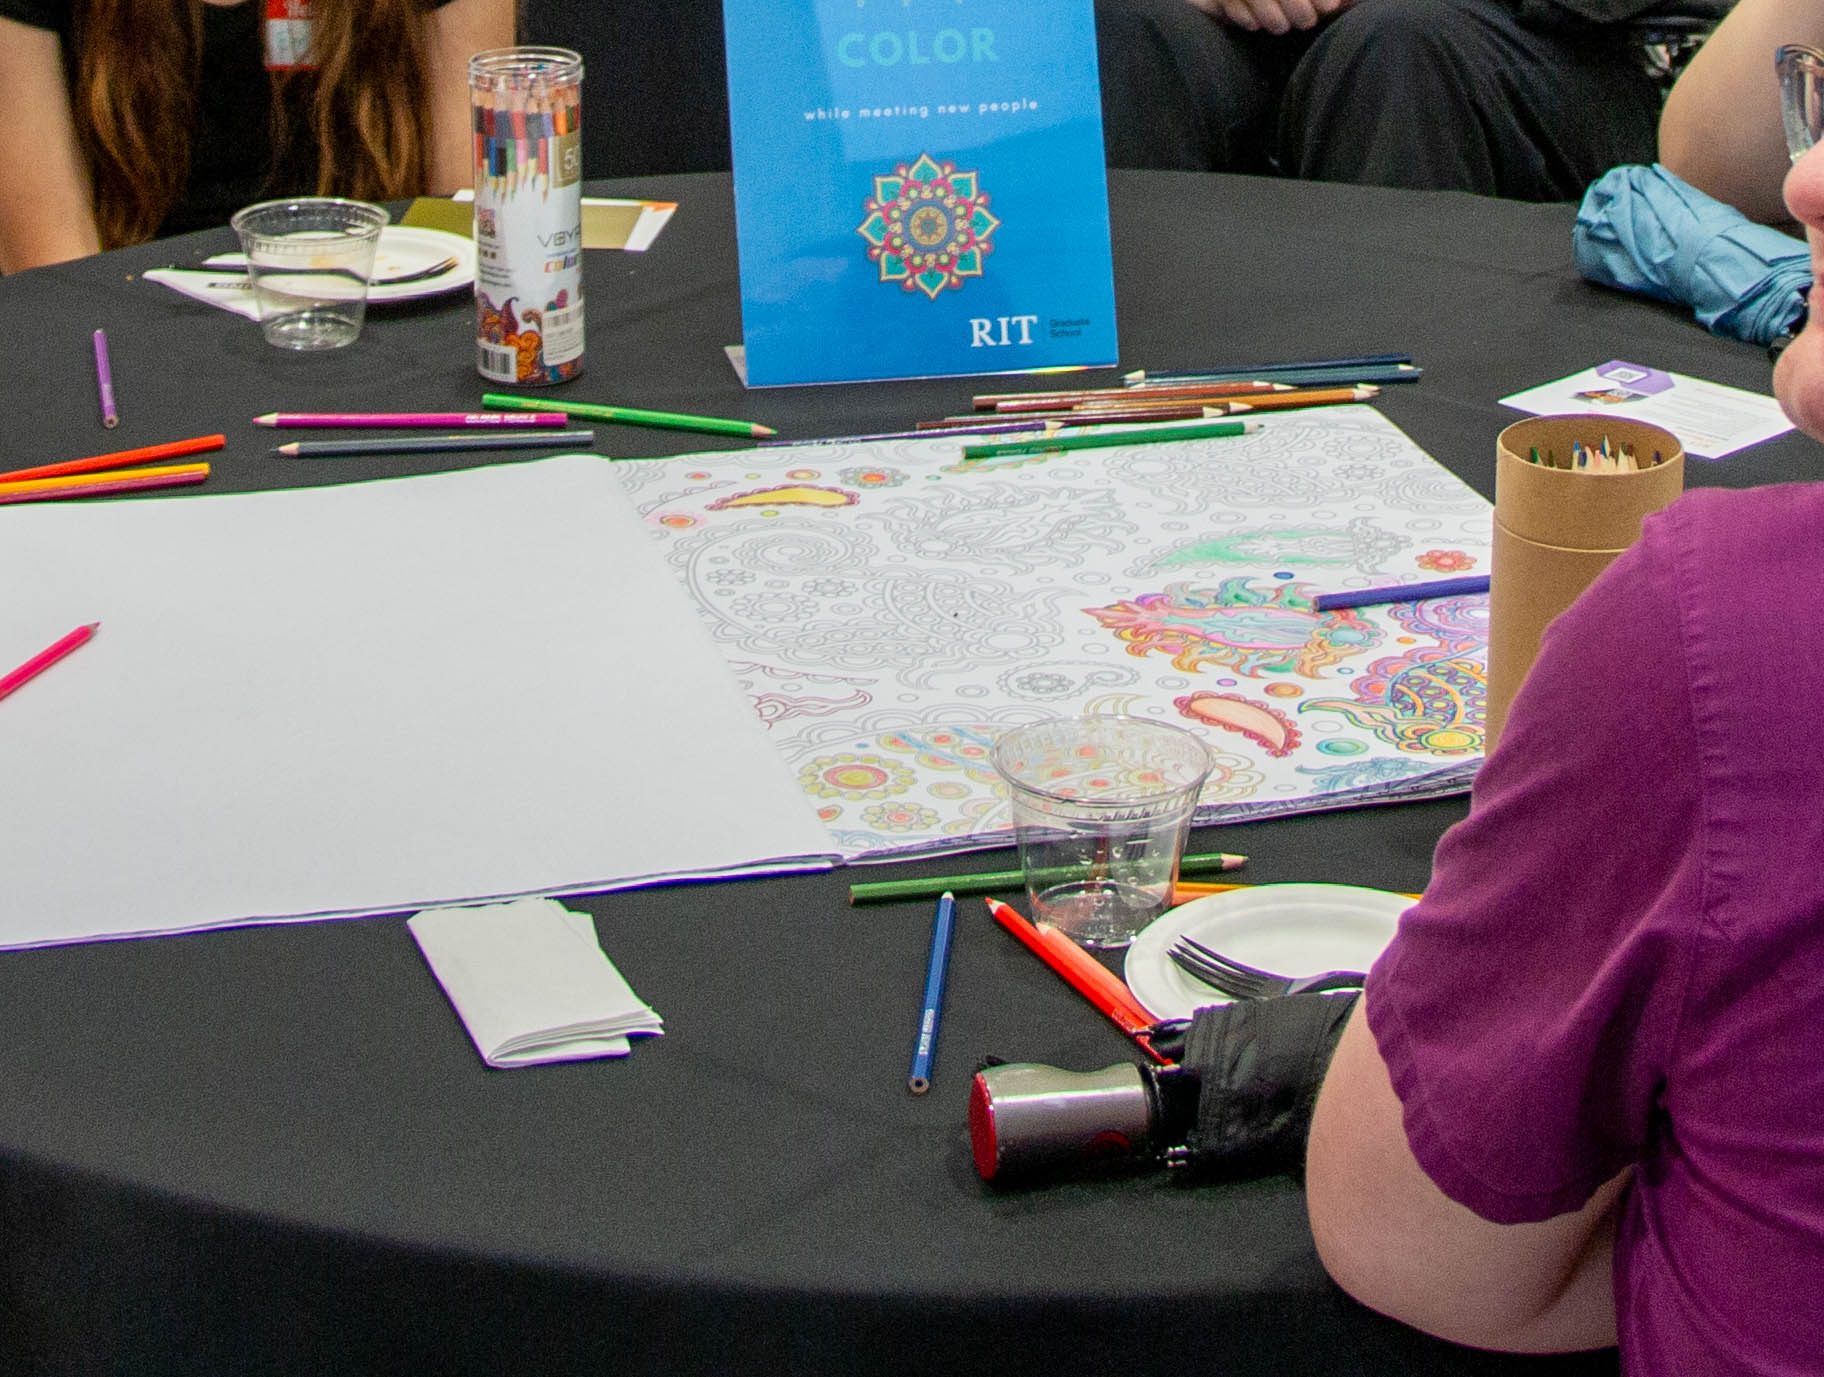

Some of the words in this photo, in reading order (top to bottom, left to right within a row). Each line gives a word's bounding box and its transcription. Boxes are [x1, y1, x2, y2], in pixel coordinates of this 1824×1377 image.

[837, 27, 999, 68] COLOR
[804, 107, 851, 121] while
[859, 105, 928, 119] meeting
[938, 102, 971, 114] new
[979, 98, 1038, 115] people
[969, 315, 1038, 348] RIT
